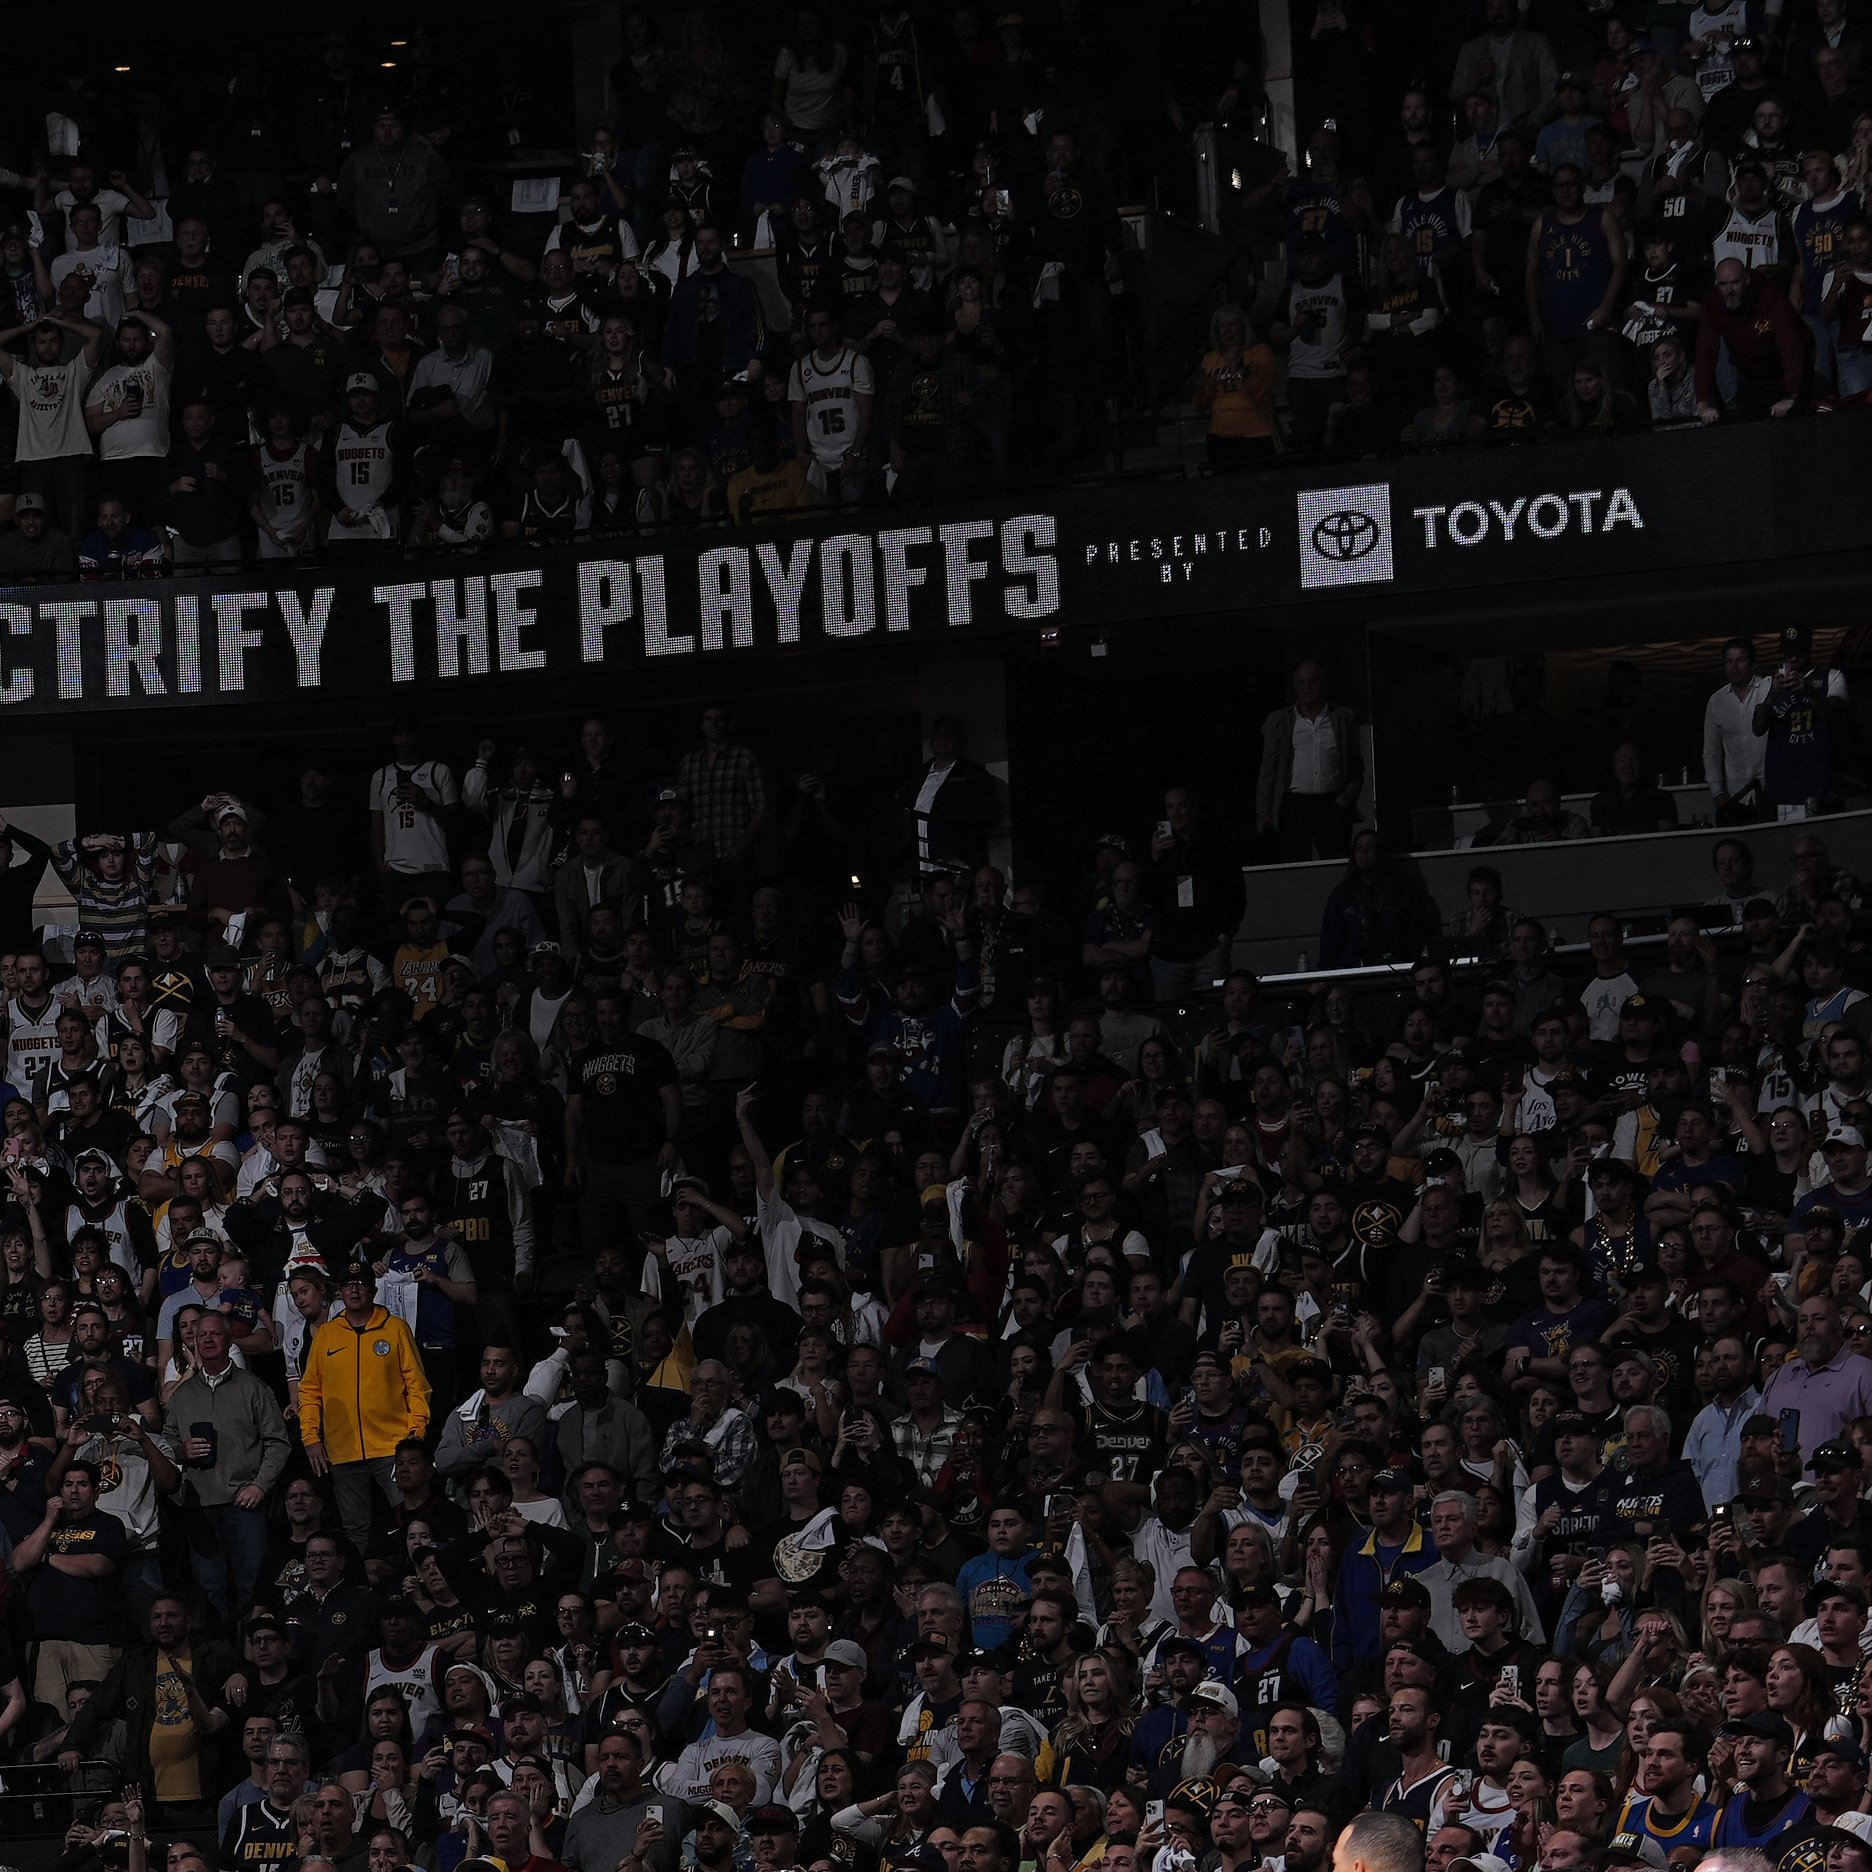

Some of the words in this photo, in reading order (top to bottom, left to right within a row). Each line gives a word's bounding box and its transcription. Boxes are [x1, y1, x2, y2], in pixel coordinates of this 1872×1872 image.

[890, 66, 902, 90] 4
[1664, 196, 1685, 219] 50
[1547, 235, 1569, 260] MILE
[1570, 235, 1591, 259] HIGH
[1728, 233, 1775, 247] NUGGETS
[1814, 233, 1833, 253] 50
[1556, 268, 1582, 281] CITY
[1656, 285, 1674, 303] 27
[604, 404, 628, 429] 27
[818, 408, 845, 435] 15
[339, 447, 387, 461] NUGGETS
[350, 460, 371, 485] 15
[274, 483, 297, 504] 15
[1413, 488, 1644, 548] TOYOTA
[1086, 528, 1272, 565] PRESENTED
[1160, 562, 1194, 583] BY
[374, 570, 546, 682] THE
[579, 514, 1058, 663] PLAYOFFS
[1776, 695, 1797, 720] MILE
[1794, 710, 1808, 730] 27
[399, 810, 415, 829] 15
[400, 961, 440, 975] LAKERS
[740, 960, 786, 977] LAKERS
[405, 976, 440, 1001] 24
[12, 1038, 62, 1052] NUGGETS
[25, 1055, 51, 1078] 27
[480, 1063, 491, 1077] 5
[583, 1056, 636, 1079] NUGGETS
[1767, 1079, 1792, 1100] 15
[469, 1180, 490, 1200] 27
[669, 1259, 713, 1276] LAKERS
[120, 1336, 145, 1356] 27
[1111, 1455, 1139, 1480] 27
[1258, 1676, 1280, 1704] 27
